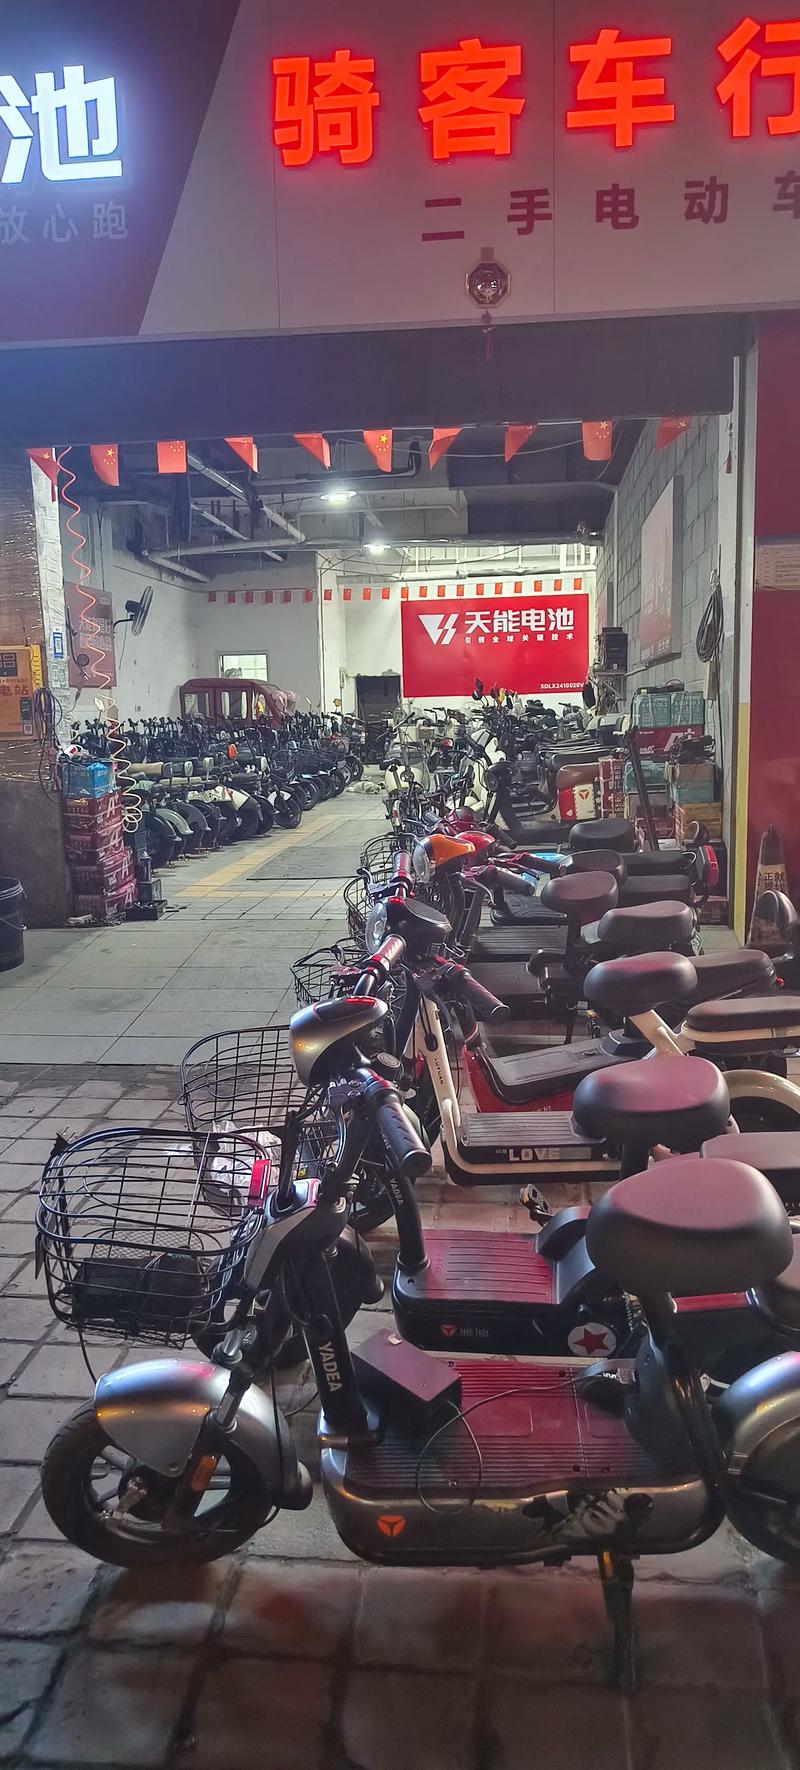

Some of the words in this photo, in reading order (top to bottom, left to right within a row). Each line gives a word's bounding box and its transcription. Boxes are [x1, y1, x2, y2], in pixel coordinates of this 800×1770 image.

[272, 17, 800, 167] 骑客车行
[0, 64, 123, 183] 池
[0, 201, 128, 244] 放心跑
[421, 170, 800, 242] 二手电动车
[464, 607, 574, 634] 天能电池
[508, 1147, 560, 1160] LOVE
[389, 1178, 404, 1206] YADEA
[318, 1341, 343, 1392] YADEA
